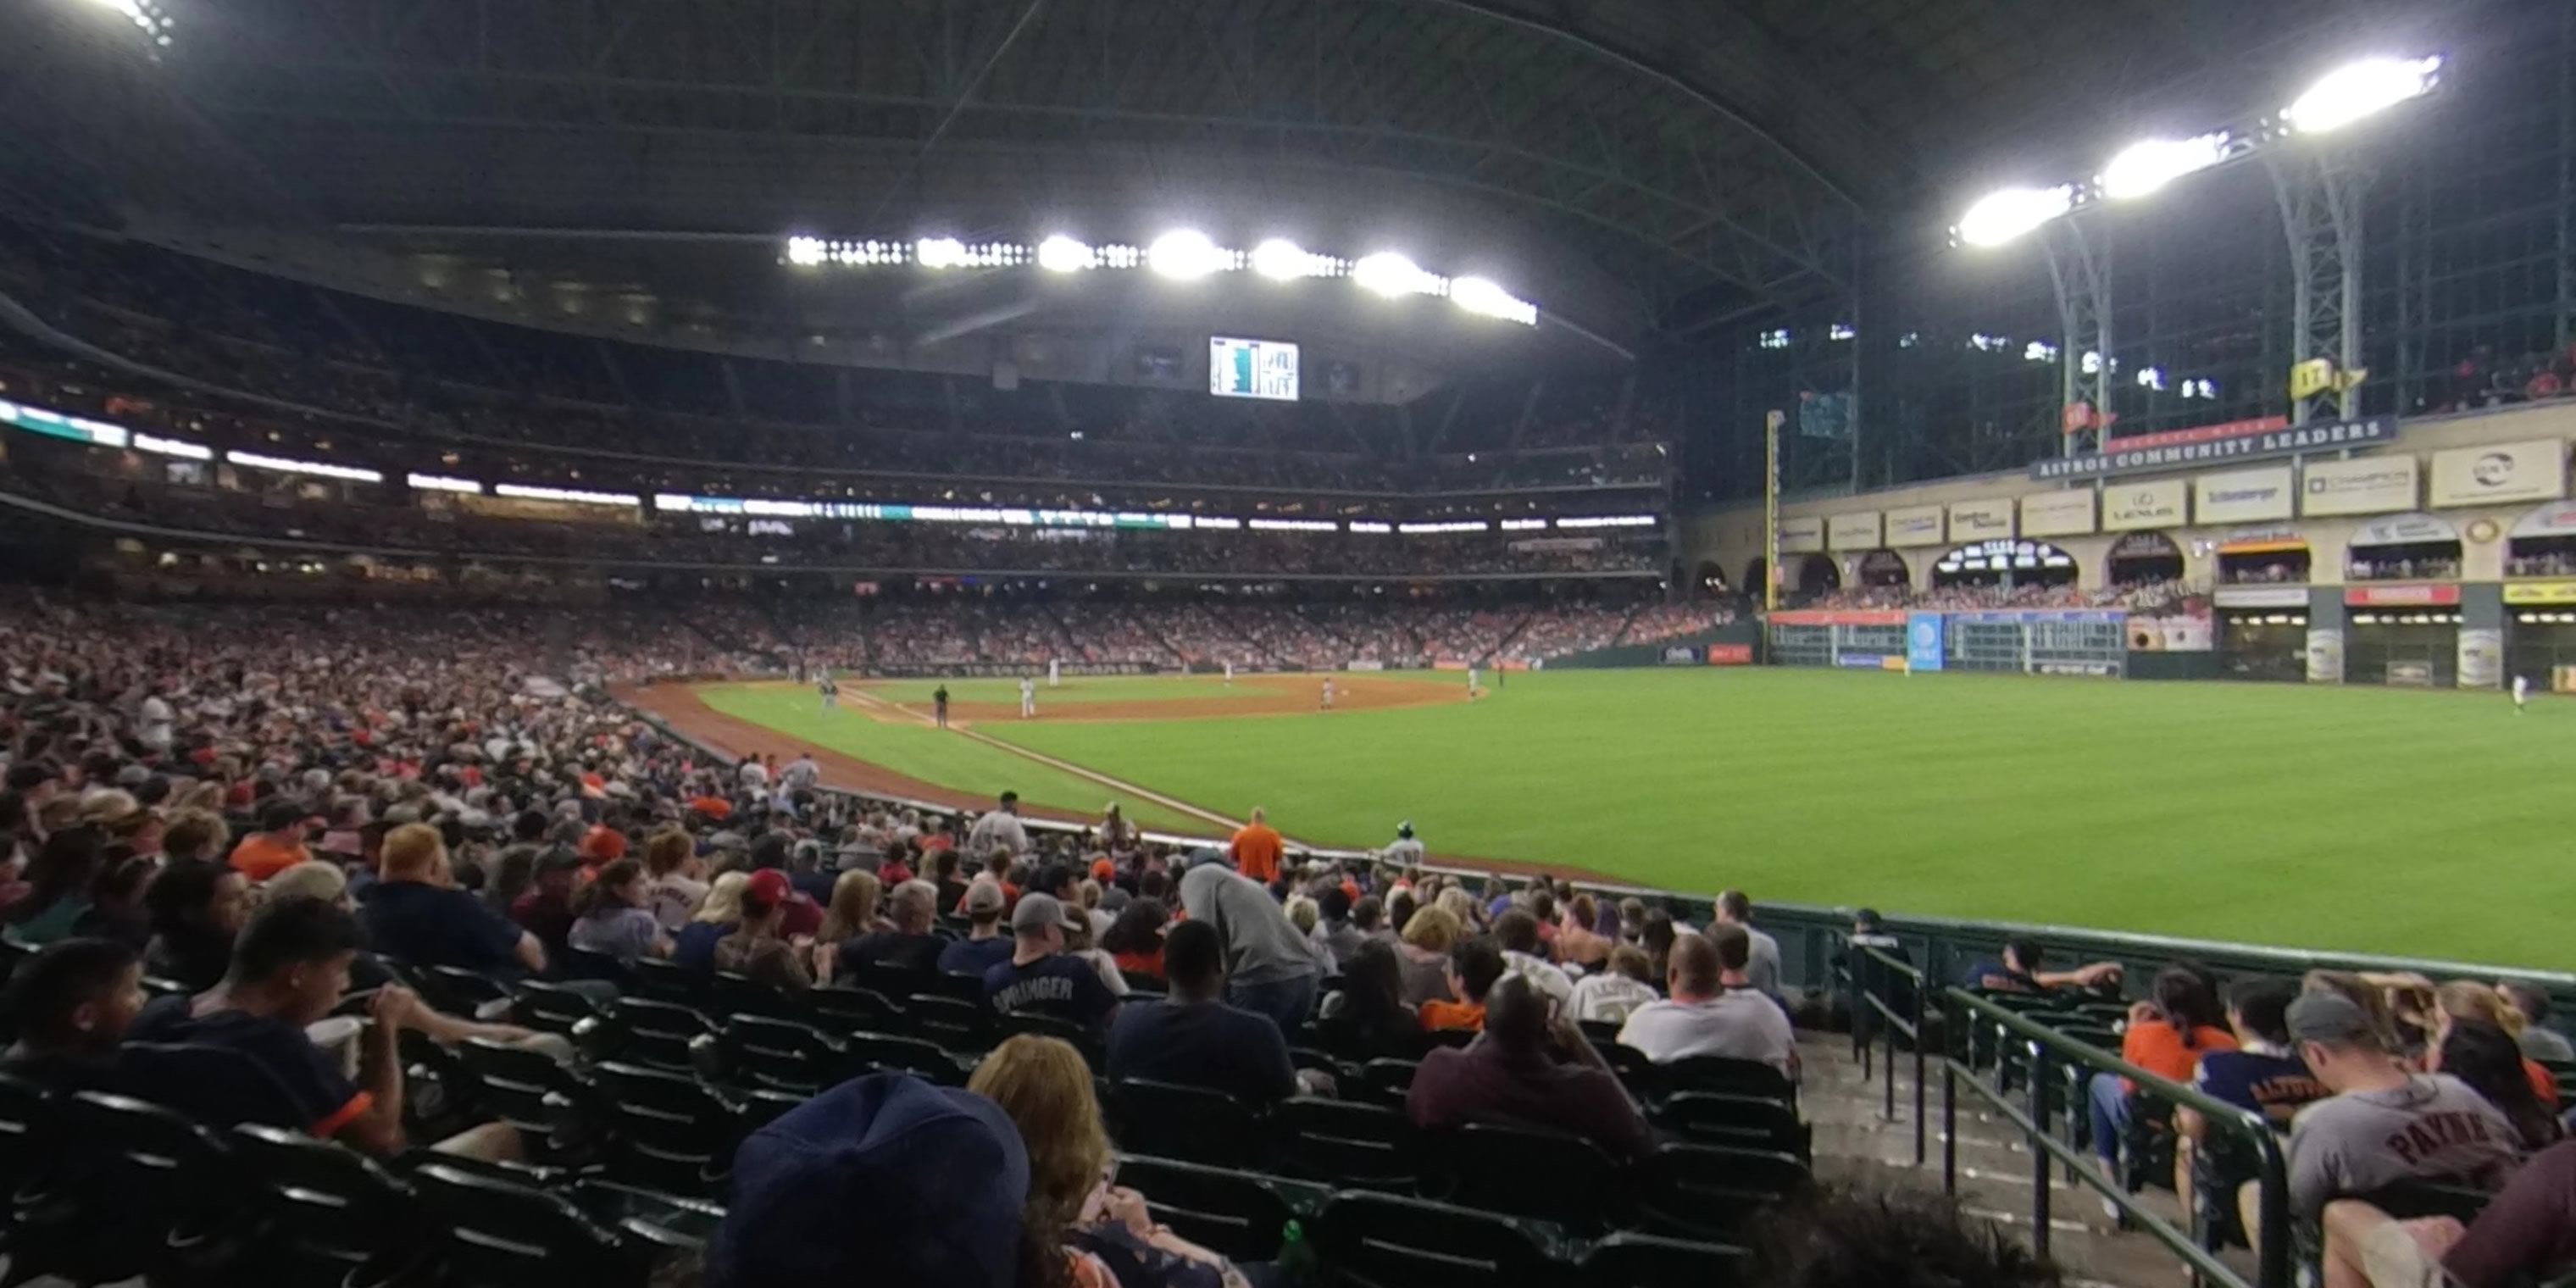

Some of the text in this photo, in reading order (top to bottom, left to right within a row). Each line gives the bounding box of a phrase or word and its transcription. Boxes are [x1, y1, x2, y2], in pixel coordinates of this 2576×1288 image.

[2040, 458, 2108, 476] ASTROS
[2116, 439, 2253, 467] COMMUNITY
[2263, 421, 2380, 450] LEADERS
[991, 975, 1073, 1014] SPRINGER
[2385, 1111, 2490, 1167] PAYNE
